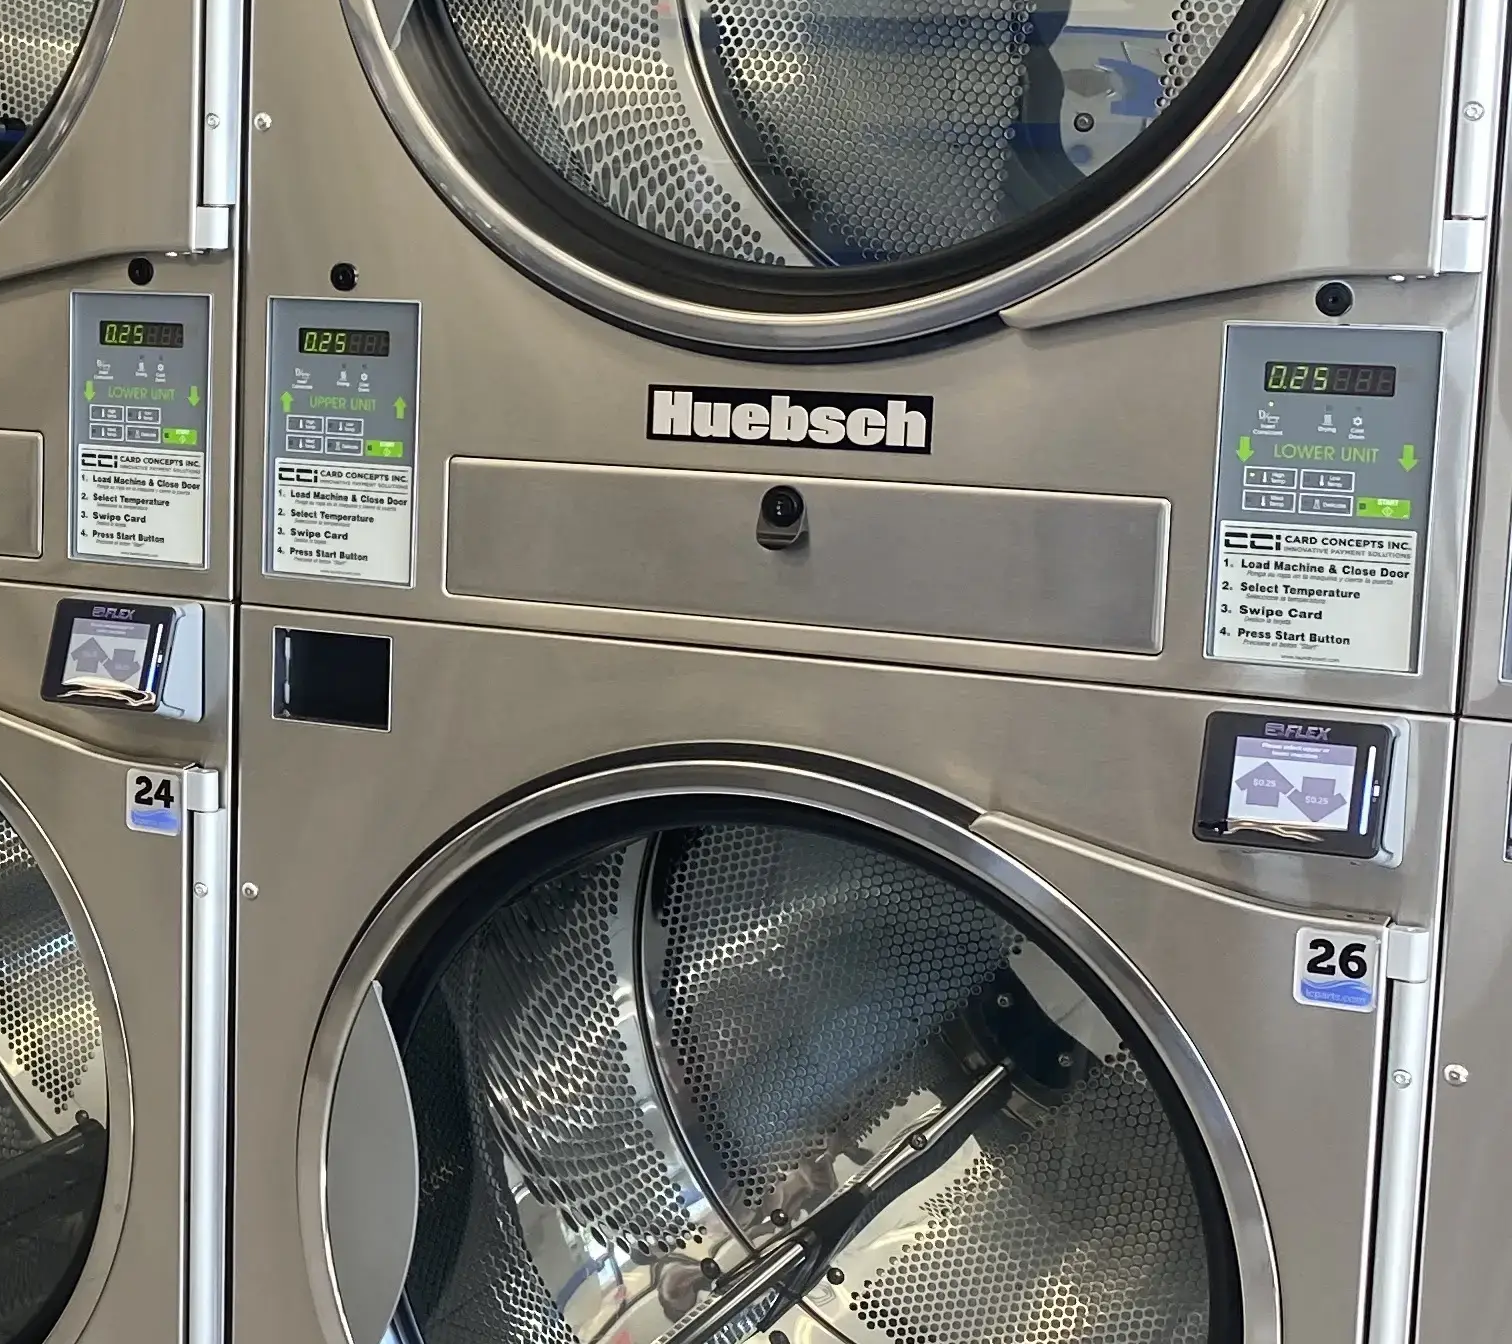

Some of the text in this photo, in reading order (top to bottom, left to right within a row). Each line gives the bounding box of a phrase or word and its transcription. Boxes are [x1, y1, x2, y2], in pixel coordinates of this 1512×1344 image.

[105, 324, 143, 344] 0.25
[304, 332, 346, 353] 0.25
[1268, 365, 1329, 391] 0.25
[108, 386, 175, 401] LOWER UNIT
[309, 395, 376, 411] UPPER UNIT
[652, 390, 927, 447] Huebsch
[1274, 443, 1380, 463] LOWER UNIT
[143, 457, 183, 466] CONCEPTS
[93, 475, 111, 483] Load
[114, 476, 146, 486] Machine
[157, 480, 179, 488] Close
[320, 470, 343, 478] CARD
[346, 472, 389, 481] CONCEPTS
[392, 474, 408, 482] INC.
[93, 493, 117, 502] Select
[120, 495, 170, 506] Temperature
[291, 490, 310, 498] Load
[313, 491, 348, 502] Machine
[361, 496, 384, 504] Close
[388, 497, 408, 506] Door
[92, 511, 121, 522] Swipe
[124, 514, 146, 523] Card
[291, 509, 317, 518] Select
[320, 511, 374, 522] Temperature
[92, 530, 114, 539] Press
[117, 532, 136, 541] Start
[138, 534, 165, 543] Button
[290, 528, 320, 538] Swipe
[324, 531, 348, 540] Card
[1285, 535, 1318, 544] CARD
[1321, 538, 1384, 548] CONCEPTS
[1388, 541, 1412, 550] INC.
[290, 547, 313, 556] Press
[316, 549, 336, 558] Start
[340, 551, 368, 561] Button
[1224, 558, 1410, 578] 1. Load Machine & Close Door
[1222, 581, 1360, 598] 2. Select Temperature
[1221, 604, 1322, 619] 3. Swipe Card
[1220, 627, 1350, 645] 4. Press Start Button
[1253, 778, 1276, 788] $0.25
[134, 776, 174, 808] 24
[1305, 796, 1328, 805] $0.25
[1307, 938, 1367, 979] 26
